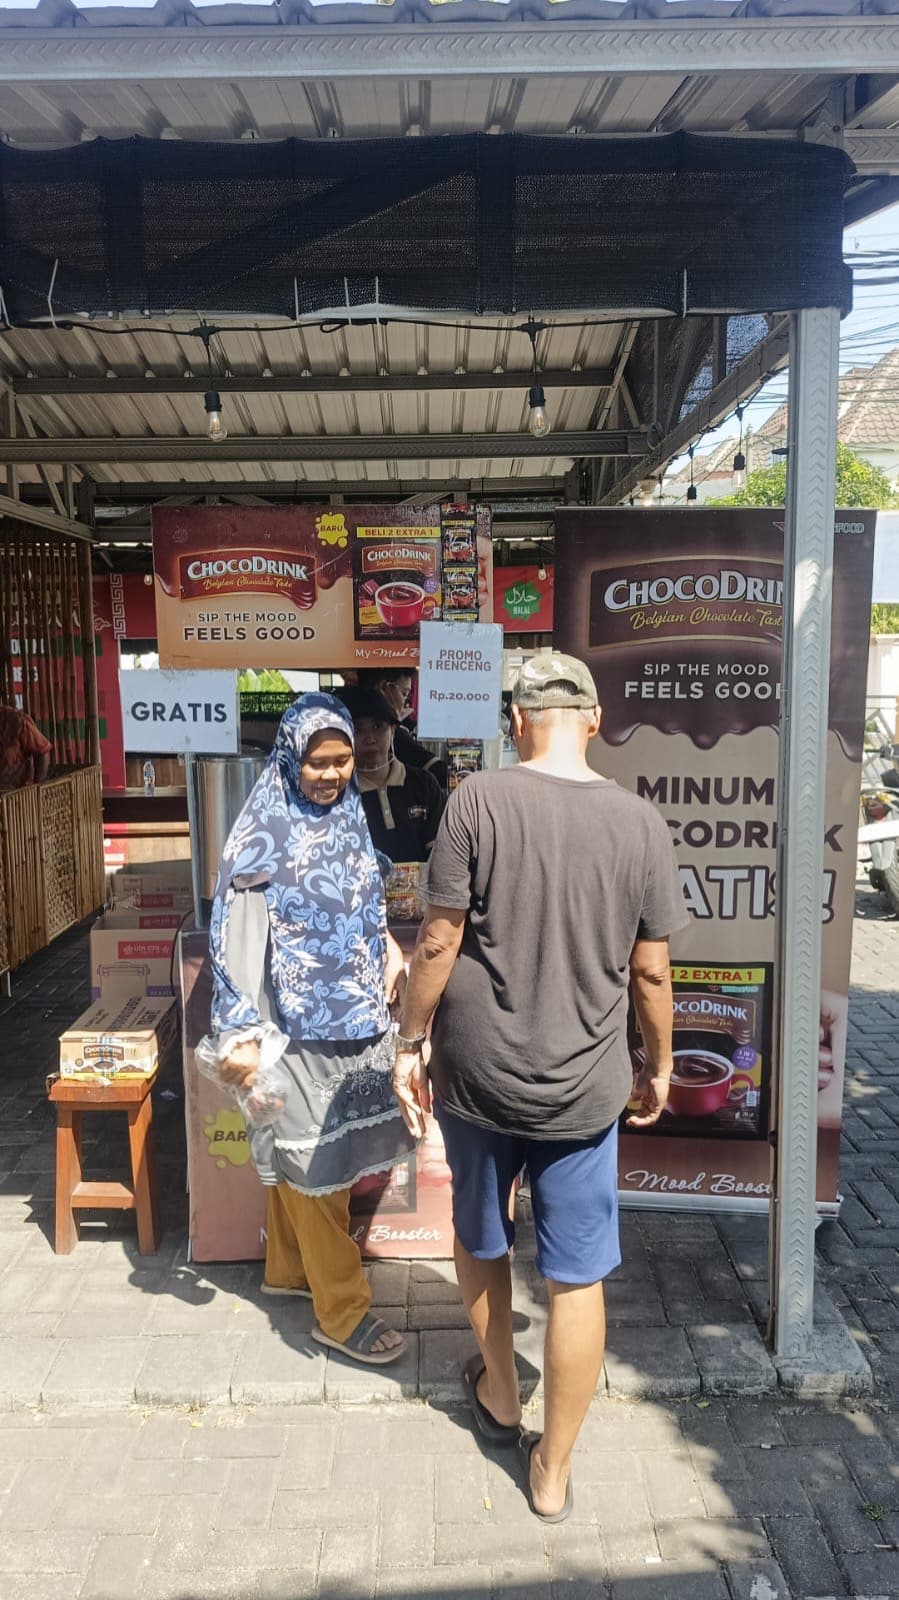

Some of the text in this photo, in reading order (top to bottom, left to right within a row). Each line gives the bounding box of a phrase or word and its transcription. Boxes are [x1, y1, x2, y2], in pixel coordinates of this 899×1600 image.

[319, 525, 344, 533] BARU
[198, 613, 297, 622] SIP THE MOOD
[630, 607, 783, 630] Belgian Chocolate Tast
[184, 627, 315, 641] FEELS GOOD
[355, 650, 371, 659] My
[439, 649, 482, 661] PROMO
[428, 660, 492, 672] 1 RENCENG
[643, 664, 769, 676] SIP THE MOOD
[429, 690, 490, 702] Rp.20.000
[624, 681, 704, 699] FEELS
[130, 701, 228, 723] GRATIS
[636, 776, 775, 806] MINUM
[680, 969, 689, 980] 2
[692, 970, 742, 981] EXTRA
[746, 971, 753, 981] 1
[213, 1130, 248, 1143] BAR
[625, 1170, 706, 1191] Mood
[369, 1225, 444, 1243] Booster
